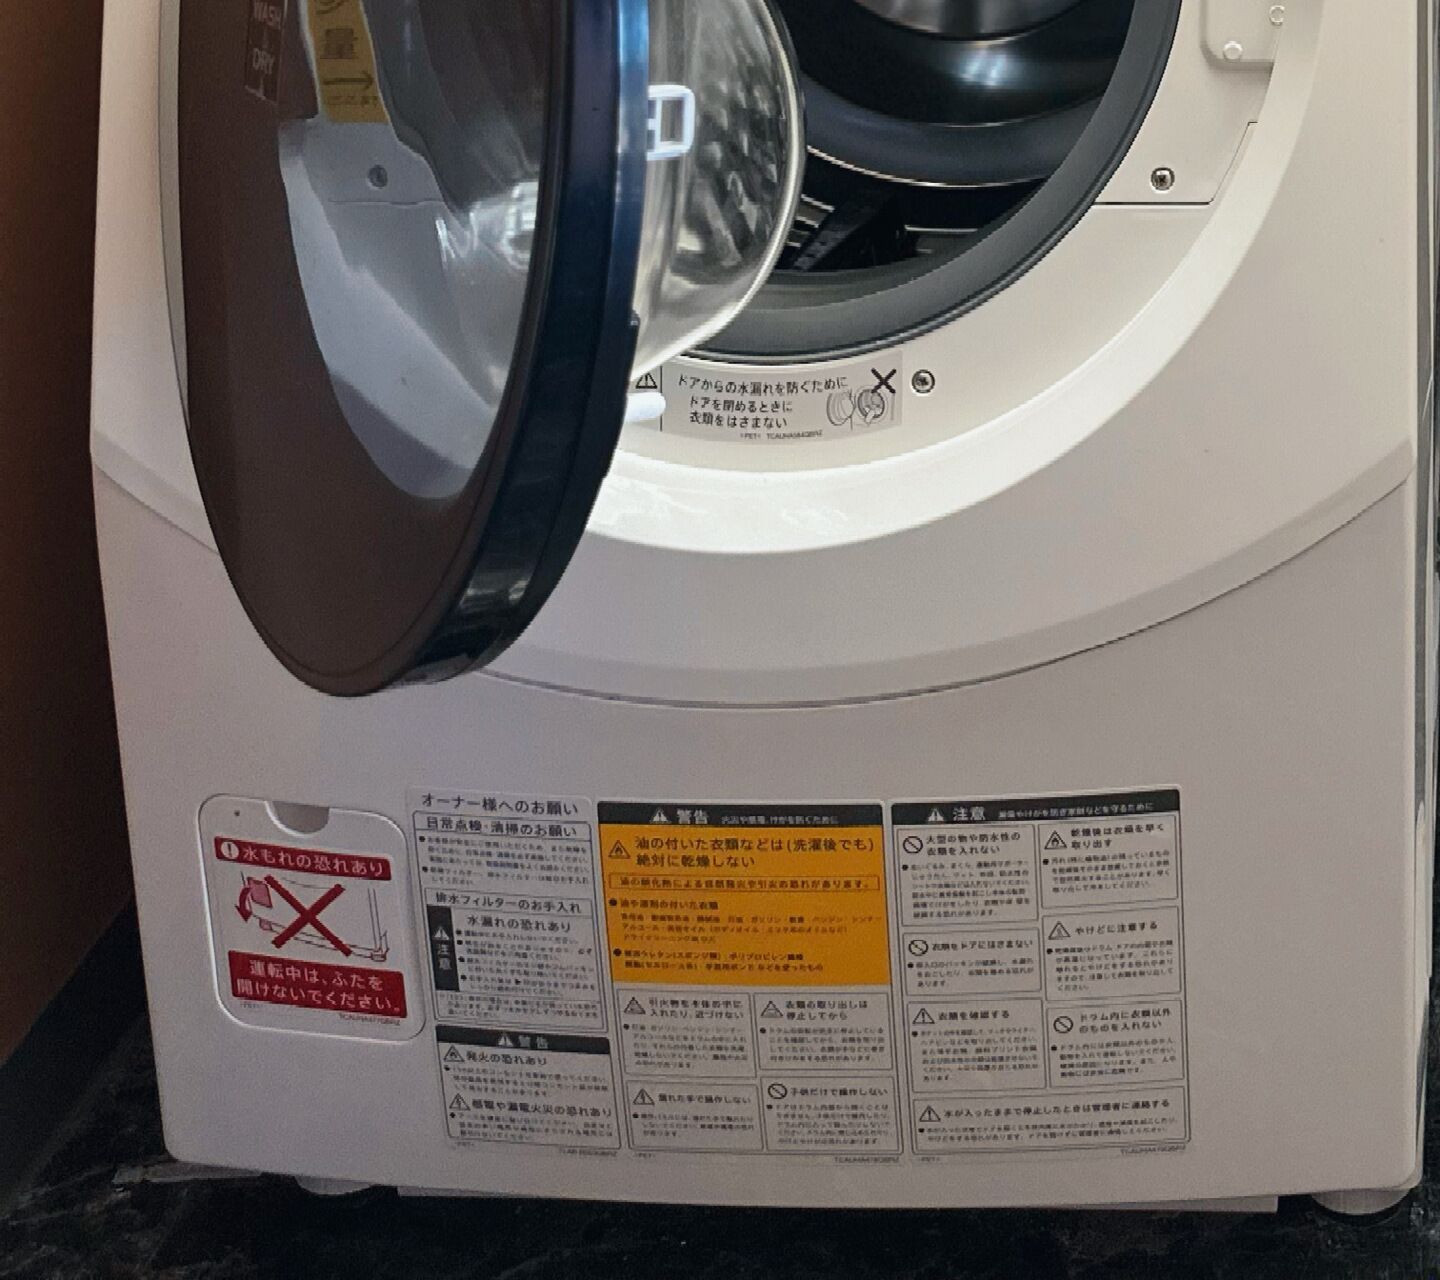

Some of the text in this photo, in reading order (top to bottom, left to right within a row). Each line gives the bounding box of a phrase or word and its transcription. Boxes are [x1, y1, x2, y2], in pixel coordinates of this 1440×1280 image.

[677, 373, 848, 395] ドアからの水漏れを防ぐために
[690, 395, 793, 414] ドアを閉めるときに
[689, 411, 788, 429] 衣類をはさまない
[420, 792, 579, 816] オーナー様へのお願い
[951, 807, 986, 822] 注意
[425, 816, 578, 838] 日常点検・清掃のお願い
[676, 808, 709, 825] 警告
[635, 836, 874, 853] 油の付いた衣類などは(洗濯後でも)
[242, 846, 387, 876] 水もれの恐れあり
[636, 853, 755, 869] 絶対に乾燥しない
[434, 891, 583, 915] 排水フィルターのお手入れ
[247, 960, 386, 991] 運転中は、ふたを
[235, 978, 401, 1013] 開けないでください。
